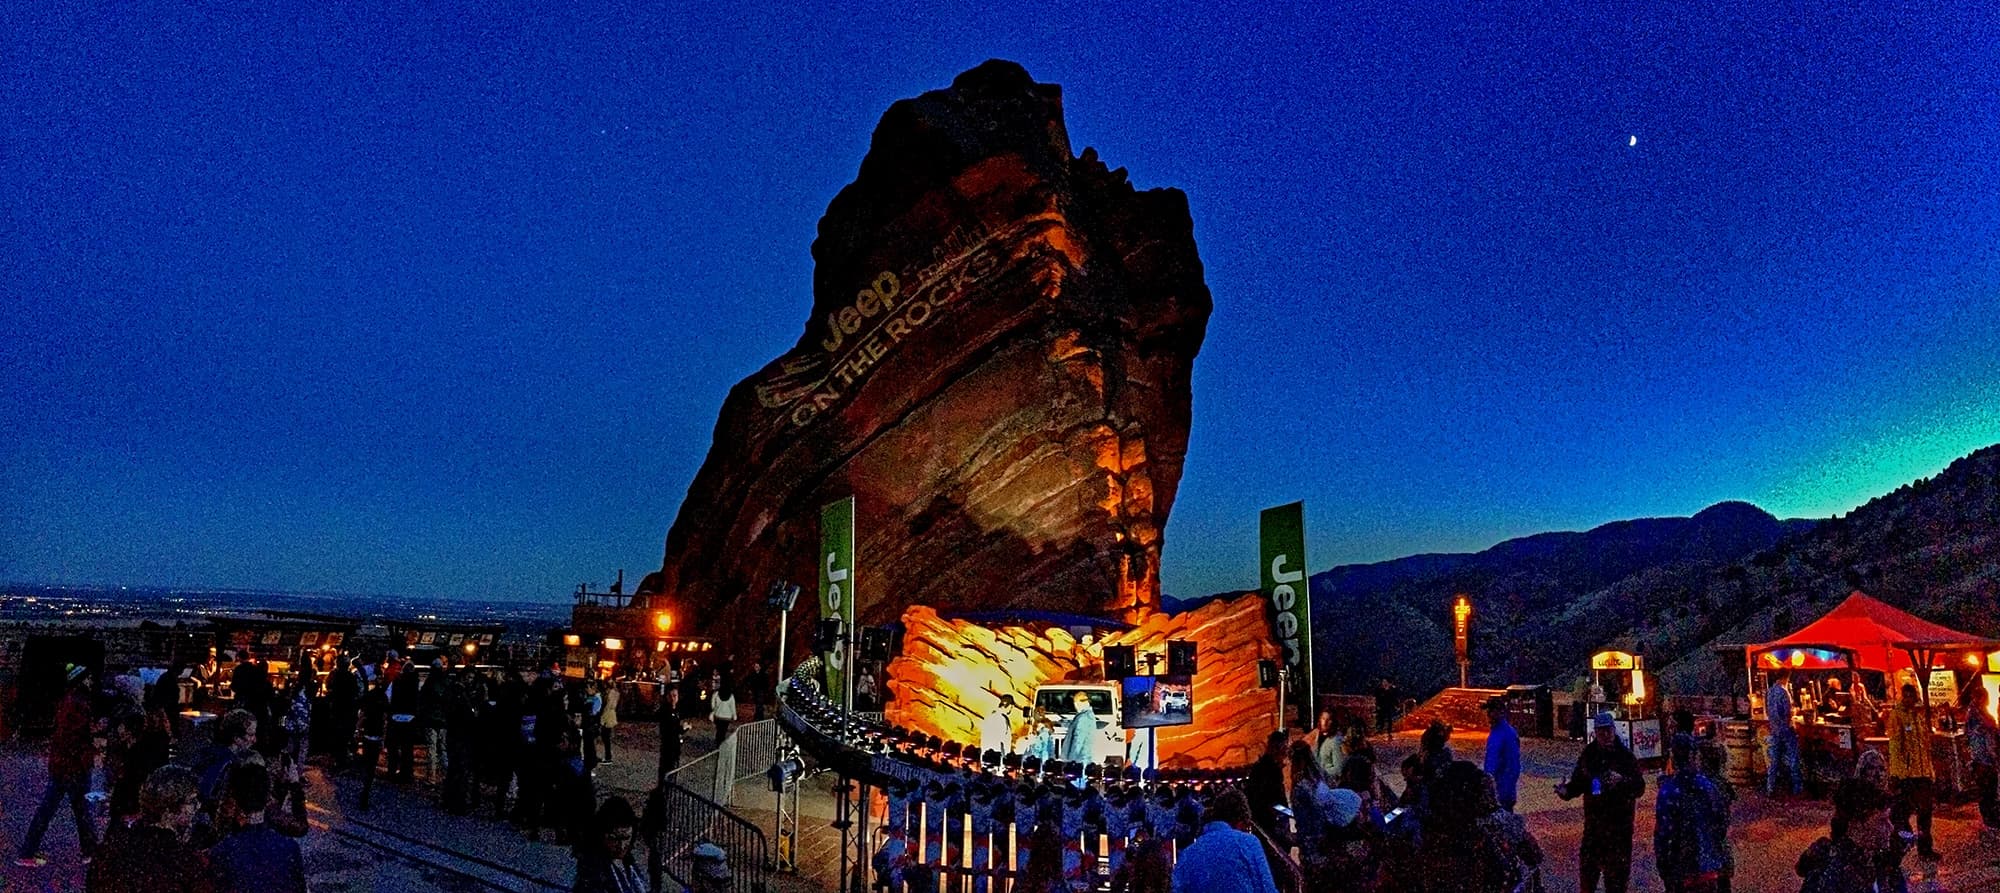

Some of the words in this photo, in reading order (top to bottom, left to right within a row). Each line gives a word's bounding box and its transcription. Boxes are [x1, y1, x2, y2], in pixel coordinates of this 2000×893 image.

[792, 384, 840, 426] ON
[835, 337, 888, 384] THE
[885, 250, 998, 343] ROCKS
[822, 270, 900, 352] Jeep
